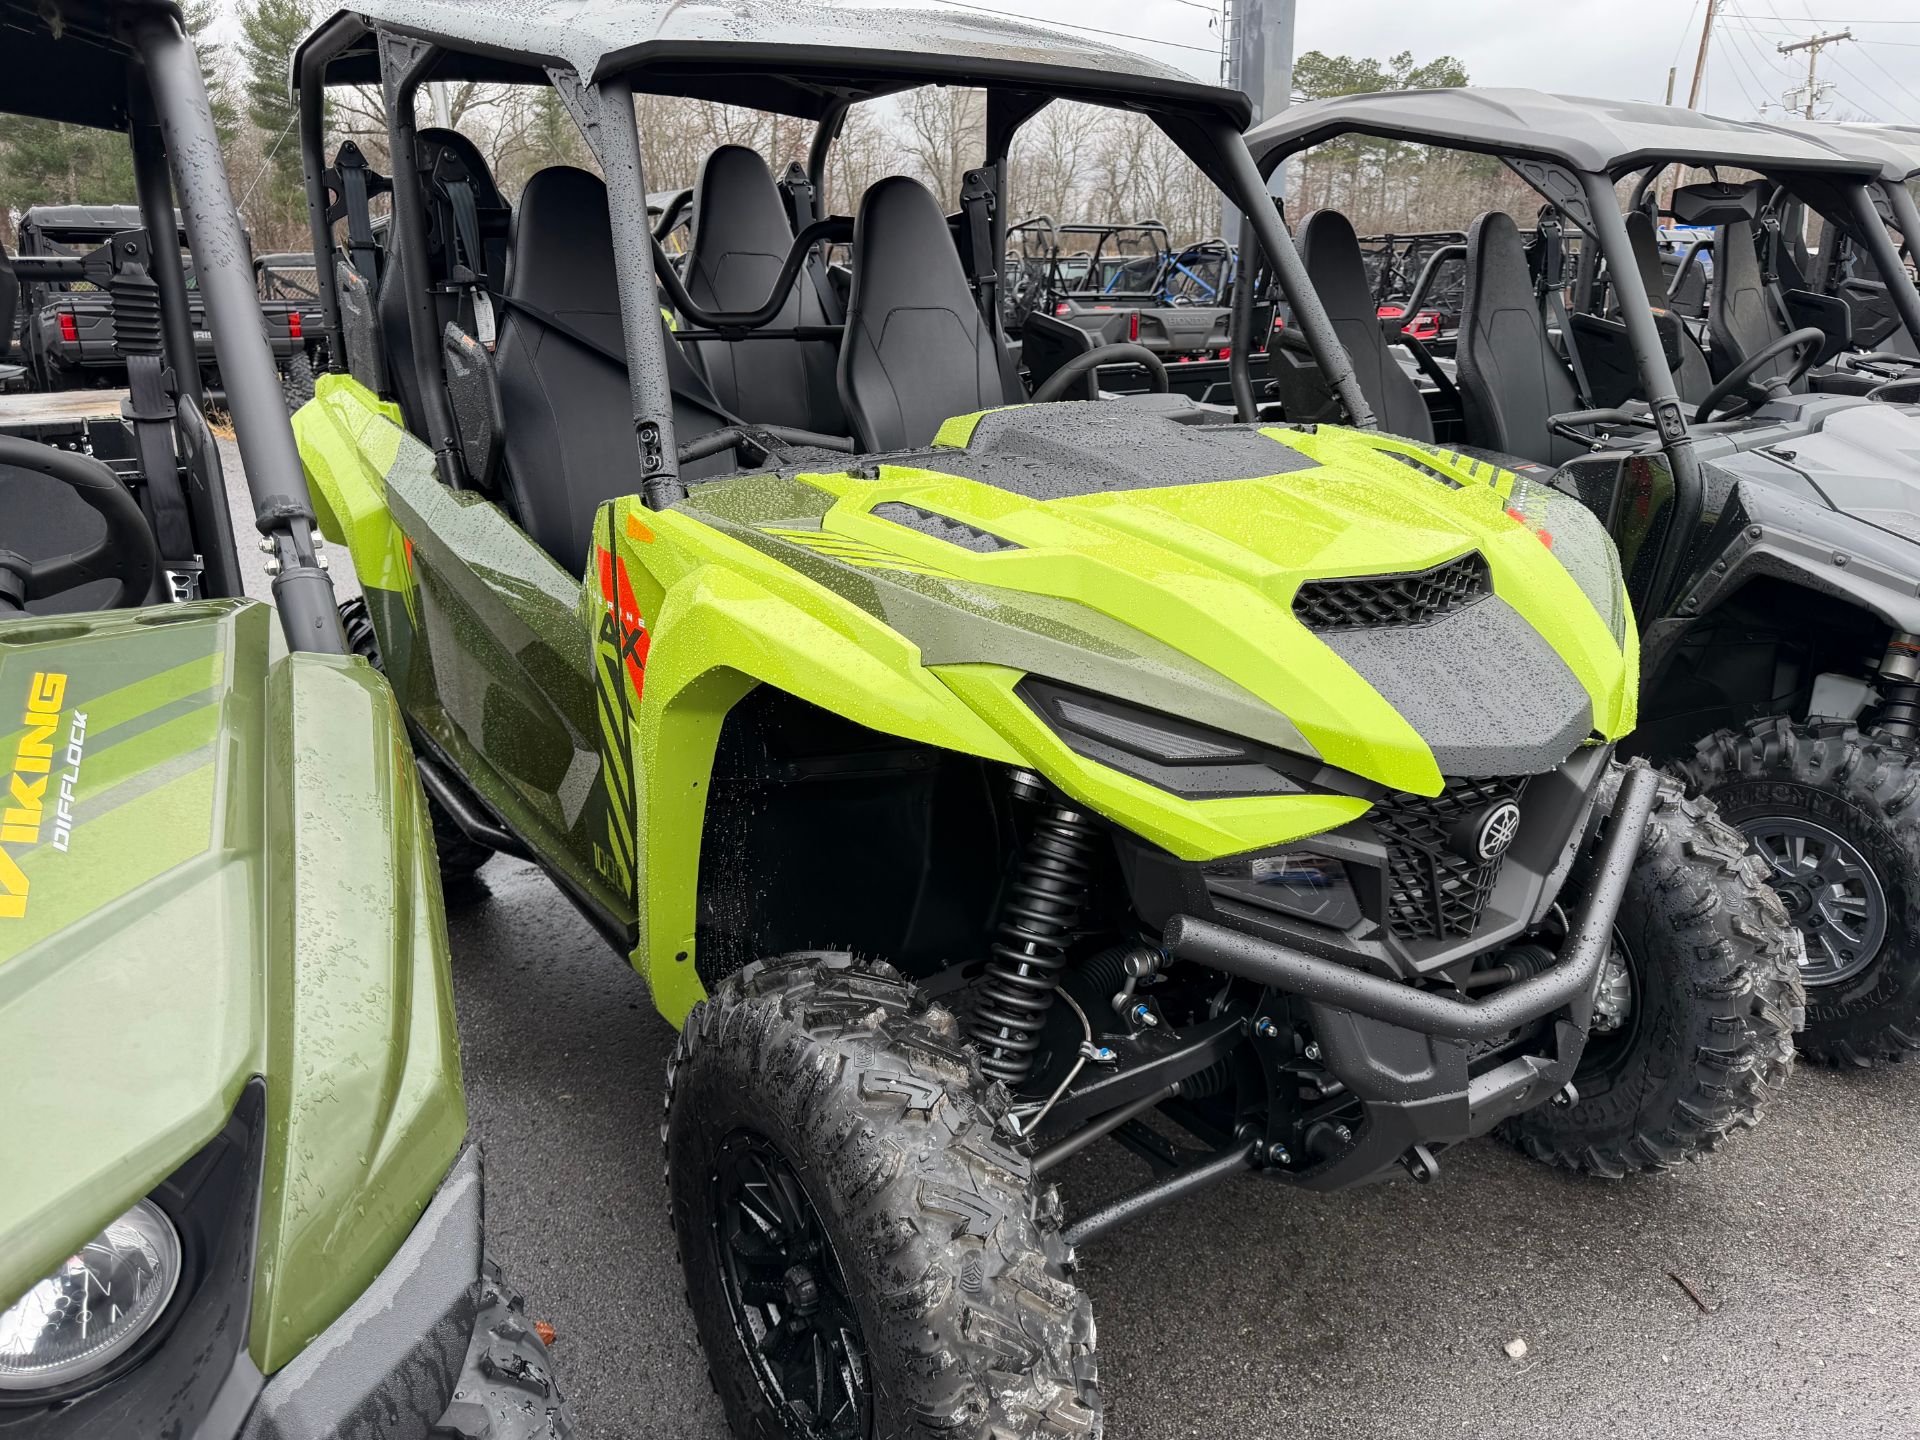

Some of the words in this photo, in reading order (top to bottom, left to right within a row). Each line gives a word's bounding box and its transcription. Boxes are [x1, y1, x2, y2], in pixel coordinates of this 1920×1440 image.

[599, 611, 646, 670] AX
[0, 672, 68, 919] VIKING
[53, 709, 89, 854] DIFFLOCK
